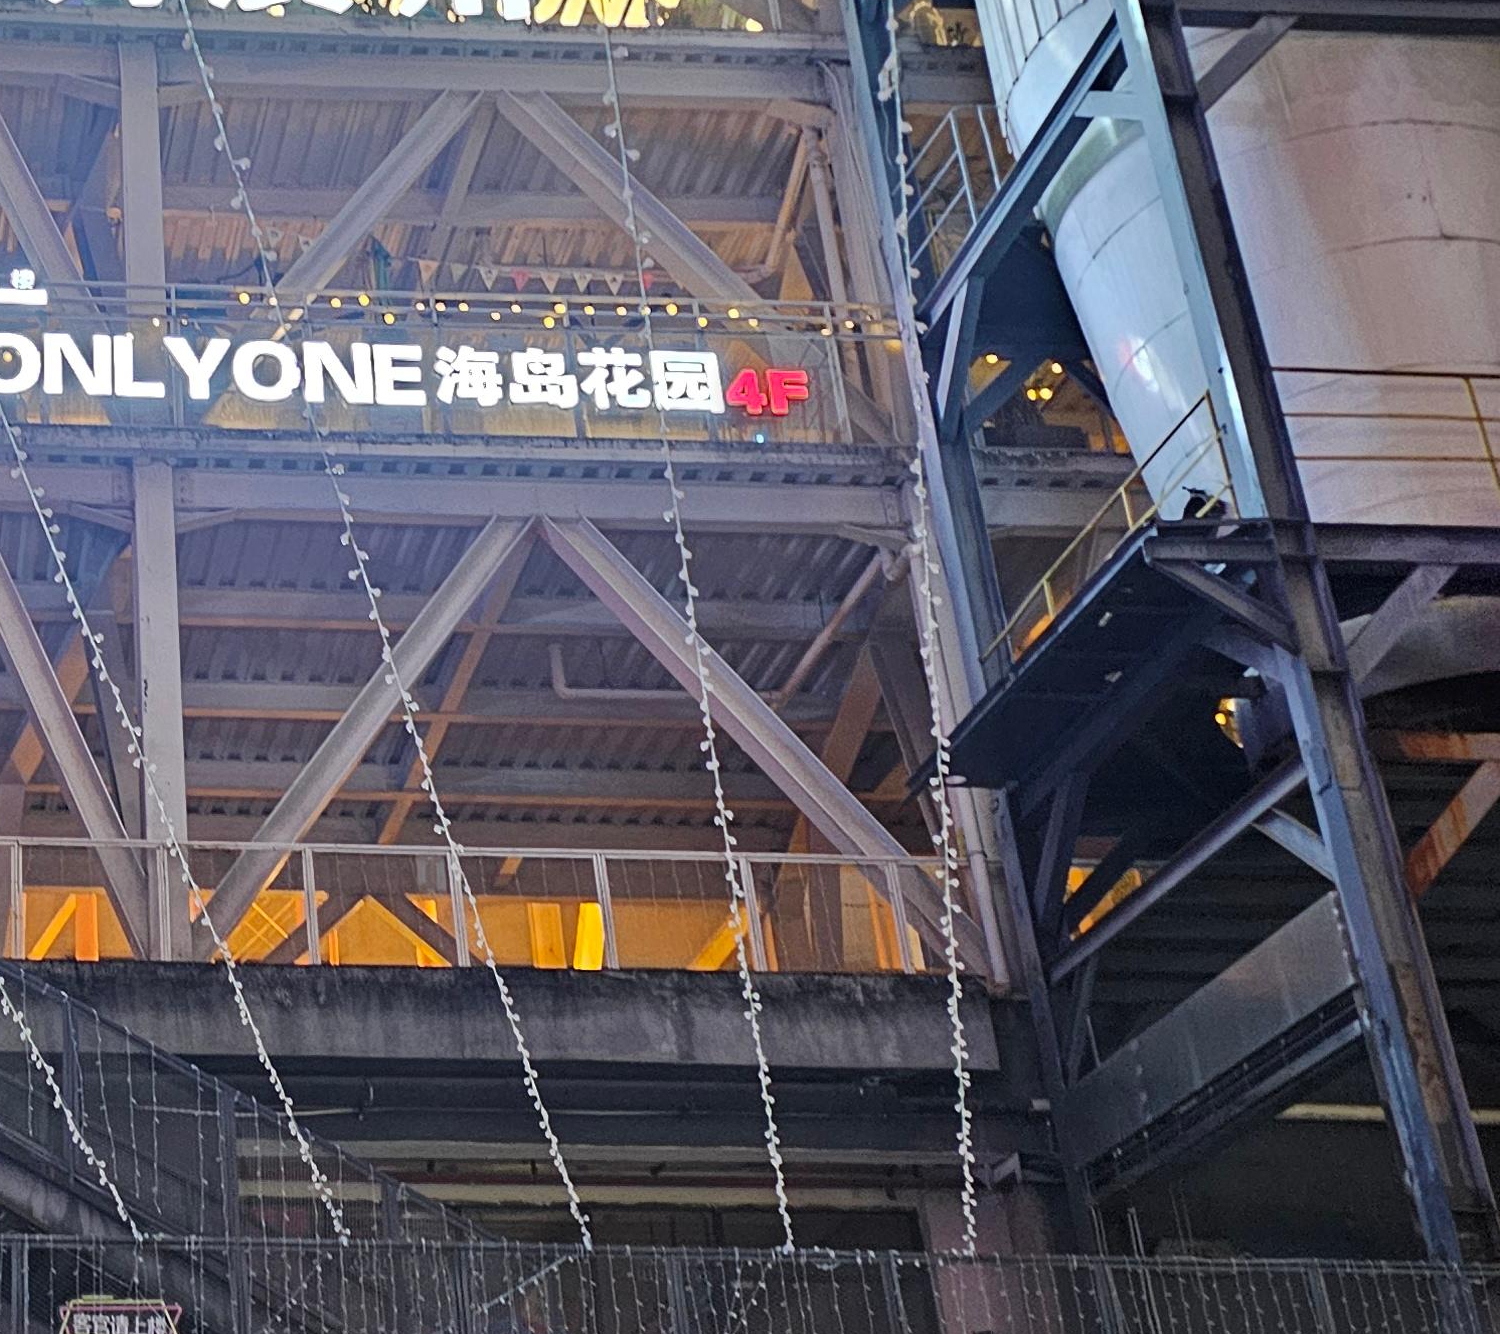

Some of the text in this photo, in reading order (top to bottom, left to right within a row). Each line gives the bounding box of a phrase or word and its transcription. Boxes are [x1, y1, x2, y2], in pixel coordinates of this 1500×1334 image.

[434, 345, 727, 415] 海岛花园
[726, 367, 813, 418] 4F
